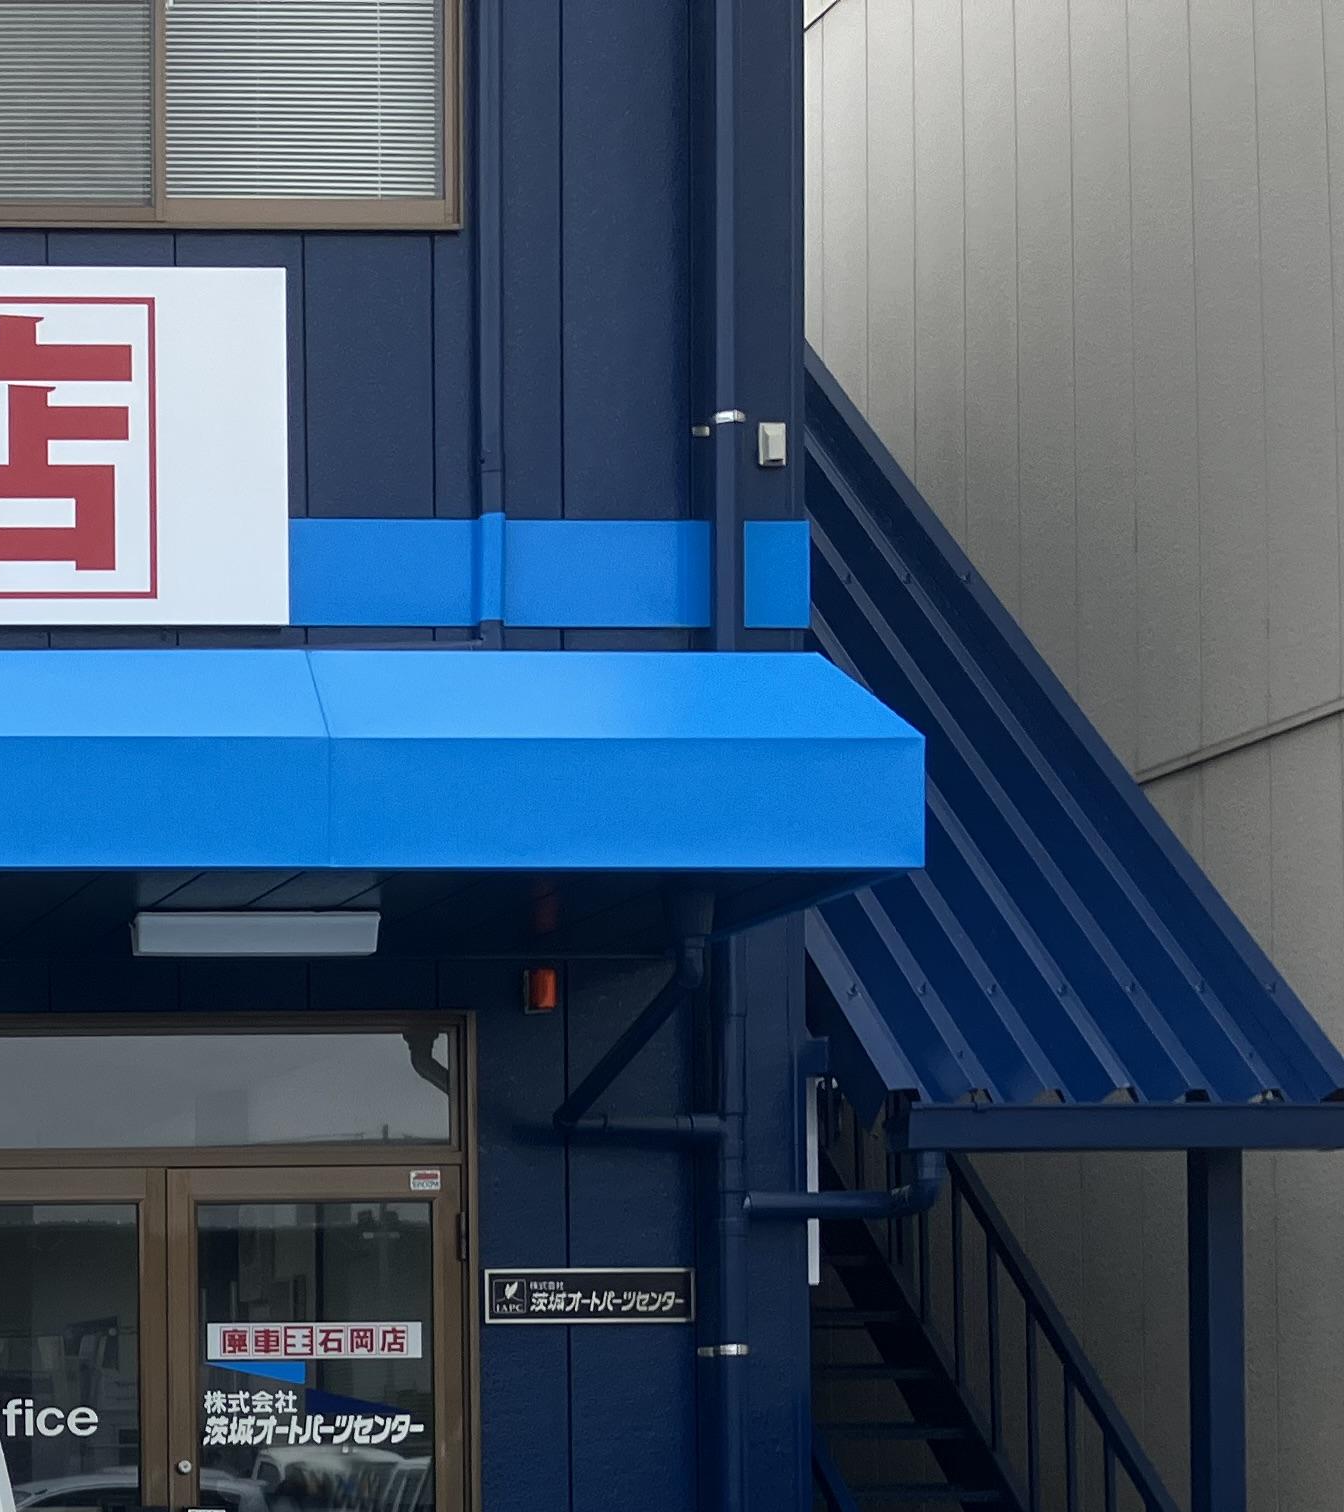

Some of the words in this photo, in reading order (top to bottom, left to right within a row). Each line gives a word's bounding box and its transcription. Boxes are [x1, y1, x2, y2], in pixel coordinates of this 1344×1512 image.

[529, 1290, 684, 1312] 茨城オートパーツセンター
[222, 1327, 407, 1355] 廃車王石岡店
[203, 1390, 298, 1413] 株式会社
[203, 1414, 425, 1445] 茨城オートパーツセンター
